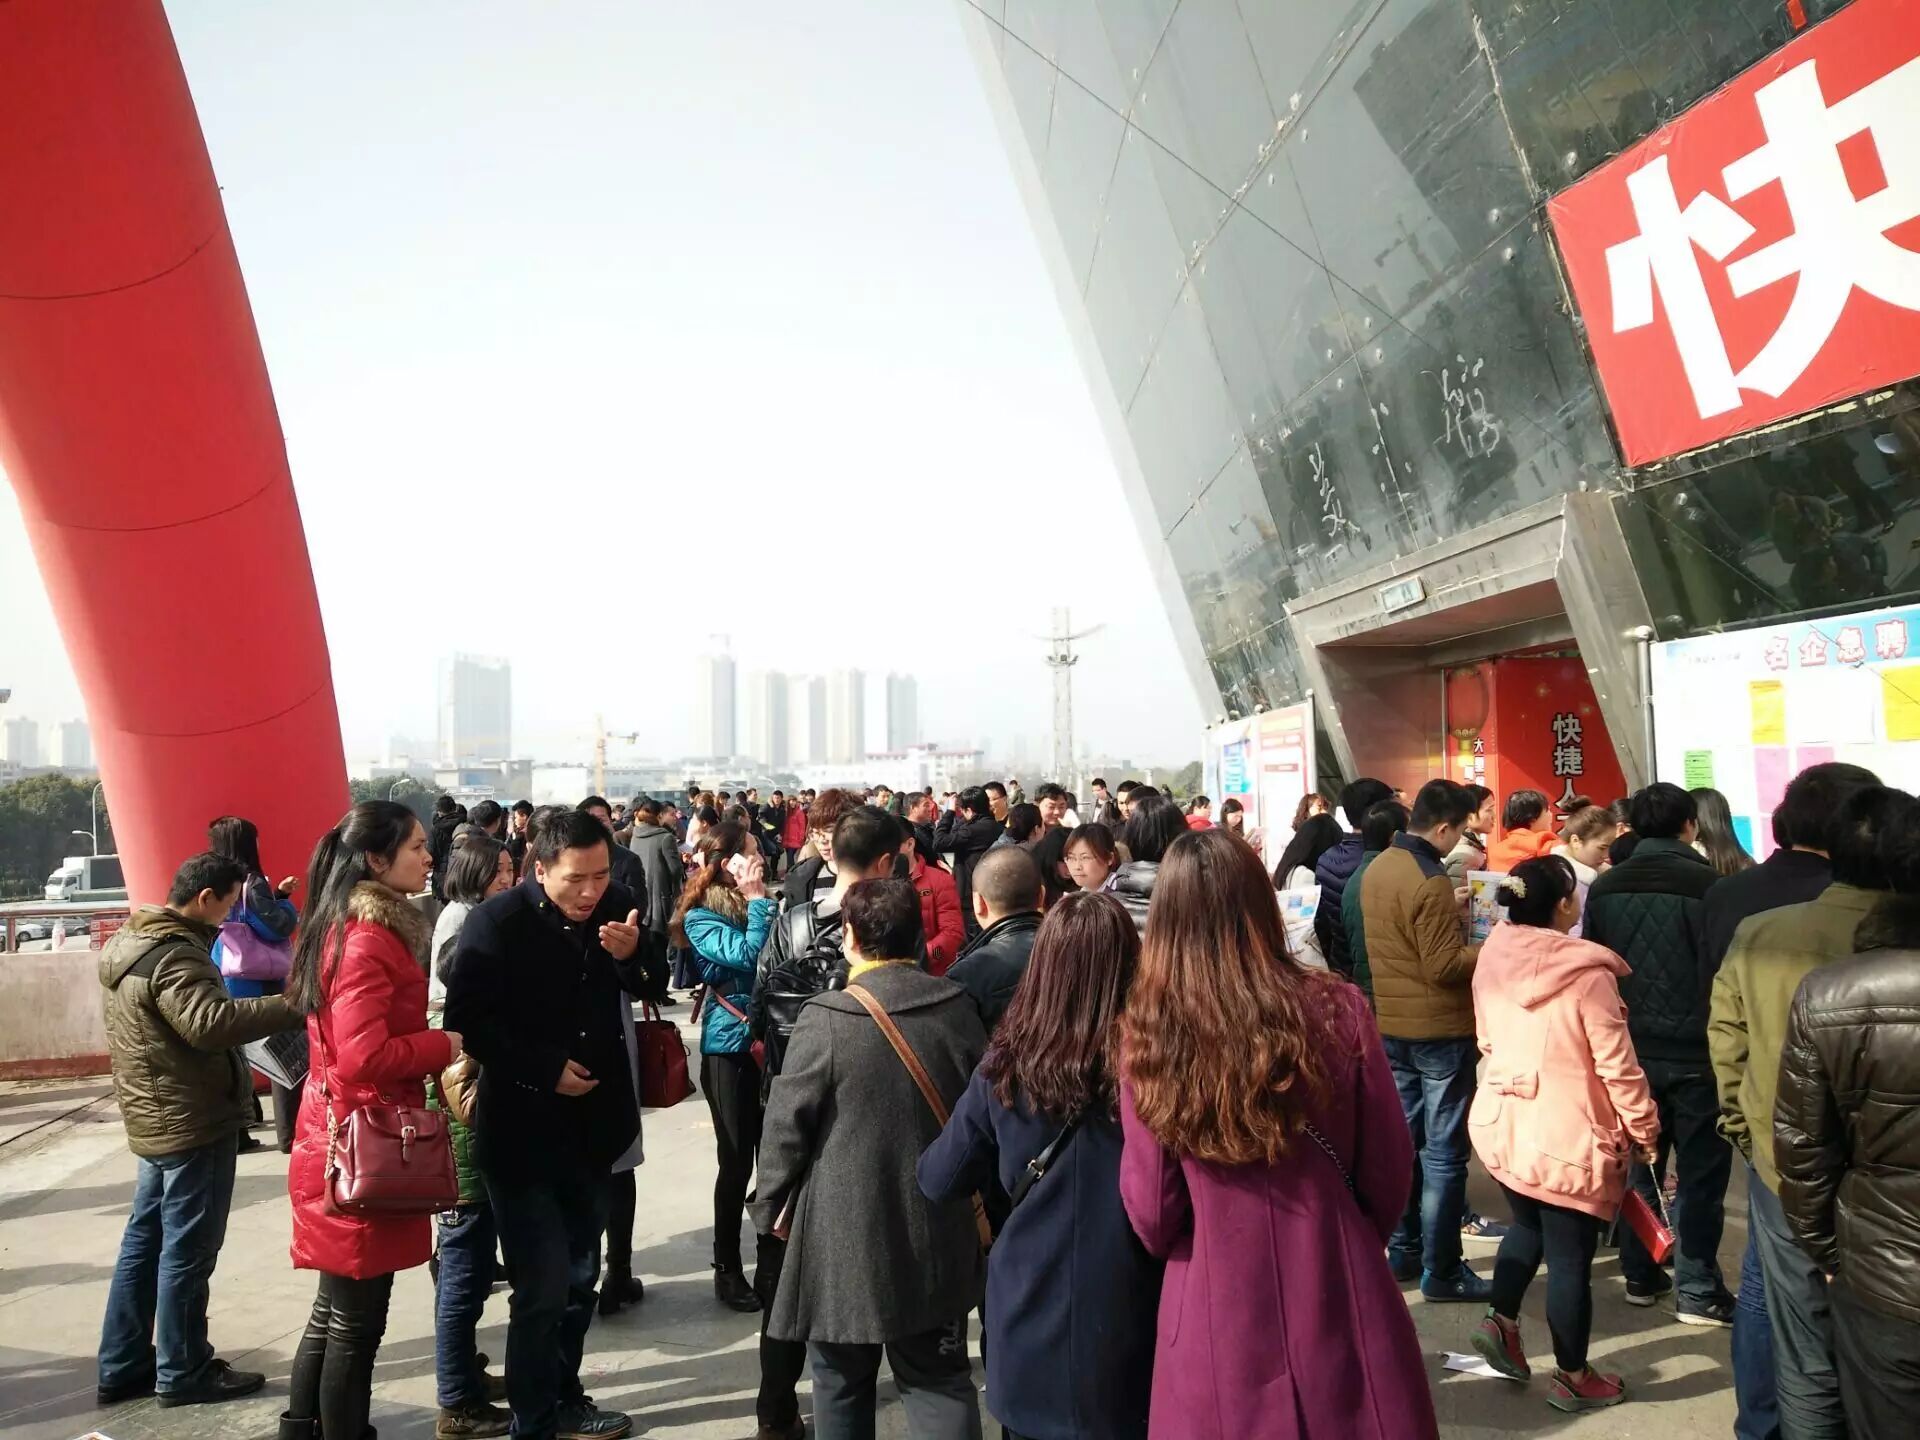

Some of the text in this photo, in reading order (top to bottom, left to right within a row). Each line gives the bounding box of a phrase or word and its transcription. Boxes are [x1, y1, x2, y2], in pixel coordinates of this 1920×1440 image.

[1605, 58, 1920, 419] 快
[1765, 619, 1907, 671] 名企急聘
[1552, 712, 1584, 835] 快捷人
